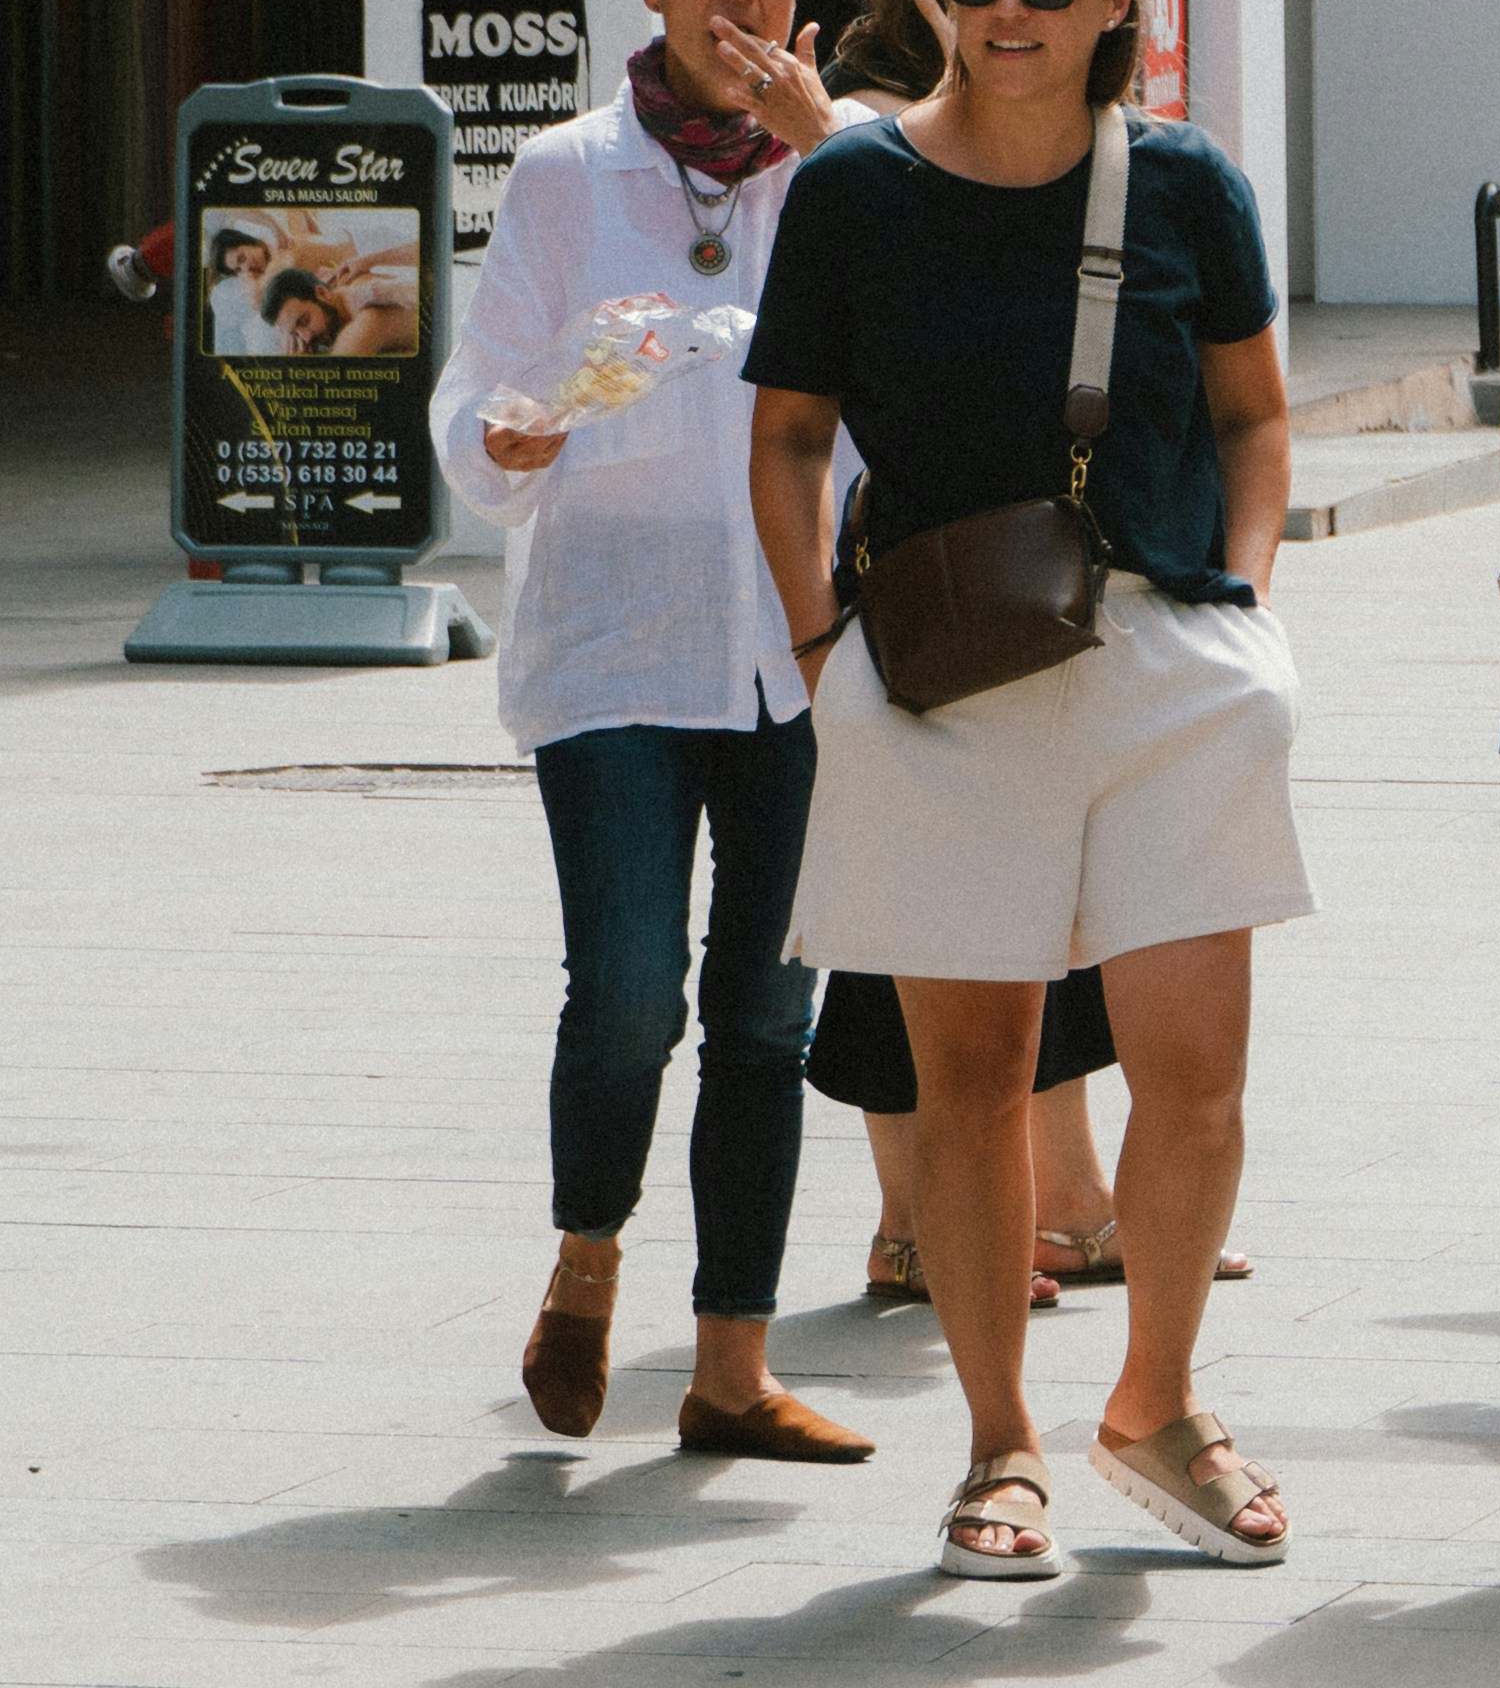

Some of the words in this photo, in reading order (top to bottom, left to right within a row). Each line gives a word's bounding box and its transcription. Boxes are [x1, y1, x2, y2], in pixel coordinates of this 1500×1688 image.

[429, 12, 577, 58] MOSS
[228, 143, 319, 184] Seven
[330, 143, 405, 184] Star
[264, 190, 286, 203] SPA
[287, 190, 296, 203] &
[298, 190, 333, 203] MASAJ
[335, 190, 378, 203] SALONU
[288, 366, 341, 386] terapi
[346, 367, 400, 385] masaj
[246, 383, 319, 400] Medikal
[323, 385, 378, 402] masaj
[267, 403, 298, 420] Vip
[303, 404, 357, 421] masaj
[317, 421, 371, 439] masaj
[218, 441, 231, 460] 0
[300, 441, 337, 460] 732
[342, 441, 368, 460] 02
[373, 441, 398, 460] 21
[218, 465, 231, 484] 0
[238, 465, 292, 486] (535)
[298, 465, 337, 484] 618
[342, 465, 367, 484] 30
[373, 465, 399, 484] 44
